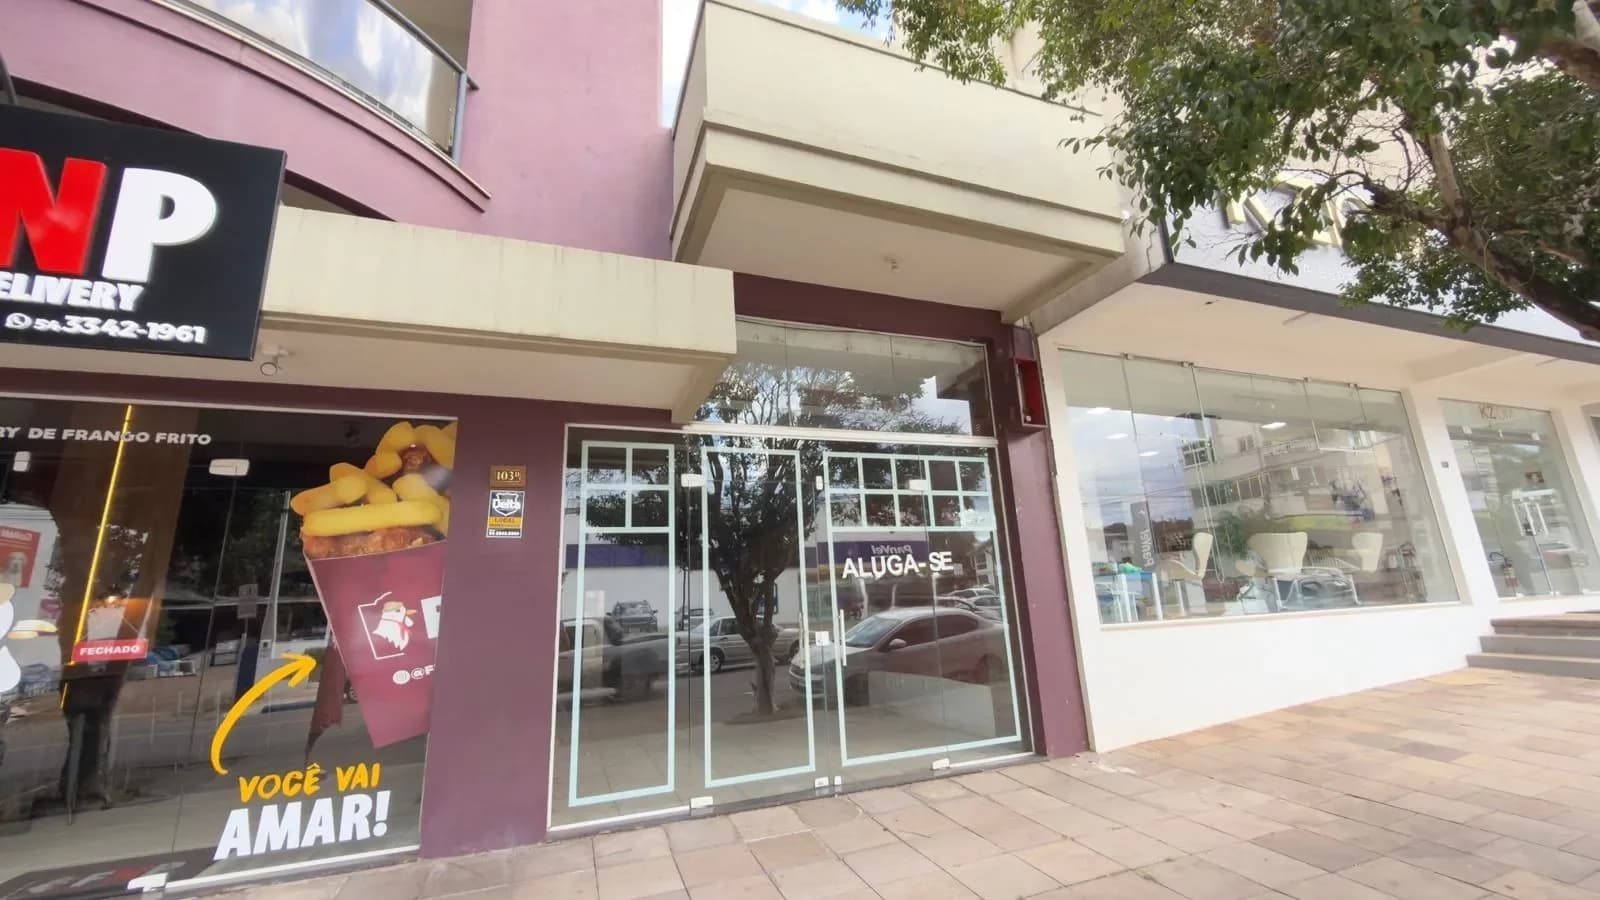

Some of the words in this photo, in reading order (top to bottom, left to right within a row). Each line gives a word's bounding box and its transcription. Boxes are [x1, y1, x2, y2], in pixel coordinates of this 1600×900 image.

[28, 427, 57, 440] DE
[62, 429, 149, 443] FRANGO
[155, 432, 212, 445] FRITO
[842, 551, 954, 579] ALUGA-SE
[79, 644, 141, 656] FECHADO
[238, 763, 321, 803] VOCÊ
[336, 762, 381, 792] VAI
[213, 790, 392, 860] AMAR!
